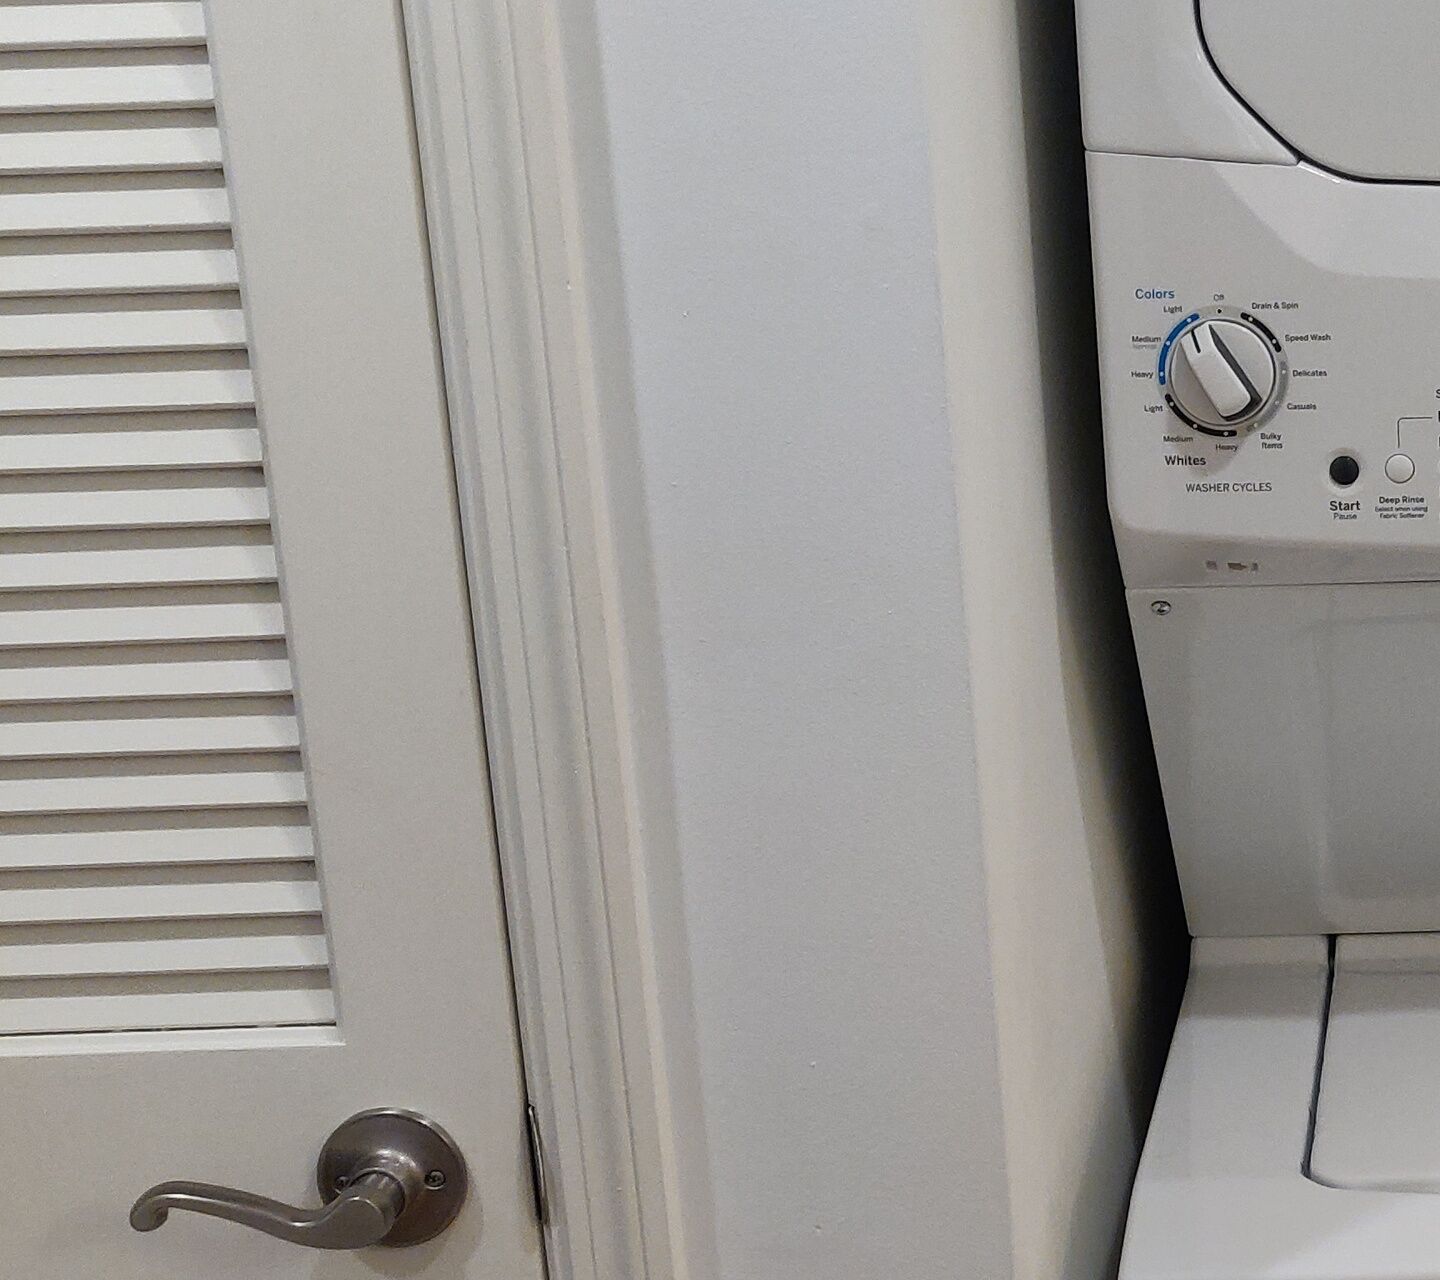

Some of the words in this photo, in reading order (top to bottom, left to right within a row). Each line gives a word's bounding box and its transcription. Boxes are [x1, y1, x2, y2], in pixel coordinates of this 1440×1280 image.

[1135, 288, 1175, 299] Colors
[1281, 302, 1298, 310] Spin
[1285, 334, 1308, 342] Speed
[1131, 371, 1153, 379] Heavy
[1144, 405, 1163, 413] Light
[1163, 435, 1193, 443] Medium
[1260, 433, 1281, 441] Bulky
[1216, 444, 1238, 452] Heavy
[1262, 442, 1283, 450] Items
[1164, 455, 1206, 466] Whites
[1186, 483, 1229, 493] WASHER
[1232, 483, 1272, 492] CYCLES
[1379, 496, 1400, 505] Deep
[1402, 495, 1425, 503] Rinse
[1329, 501, 1361, 511] Start
[1333, 512, 1357, 520] Pause
